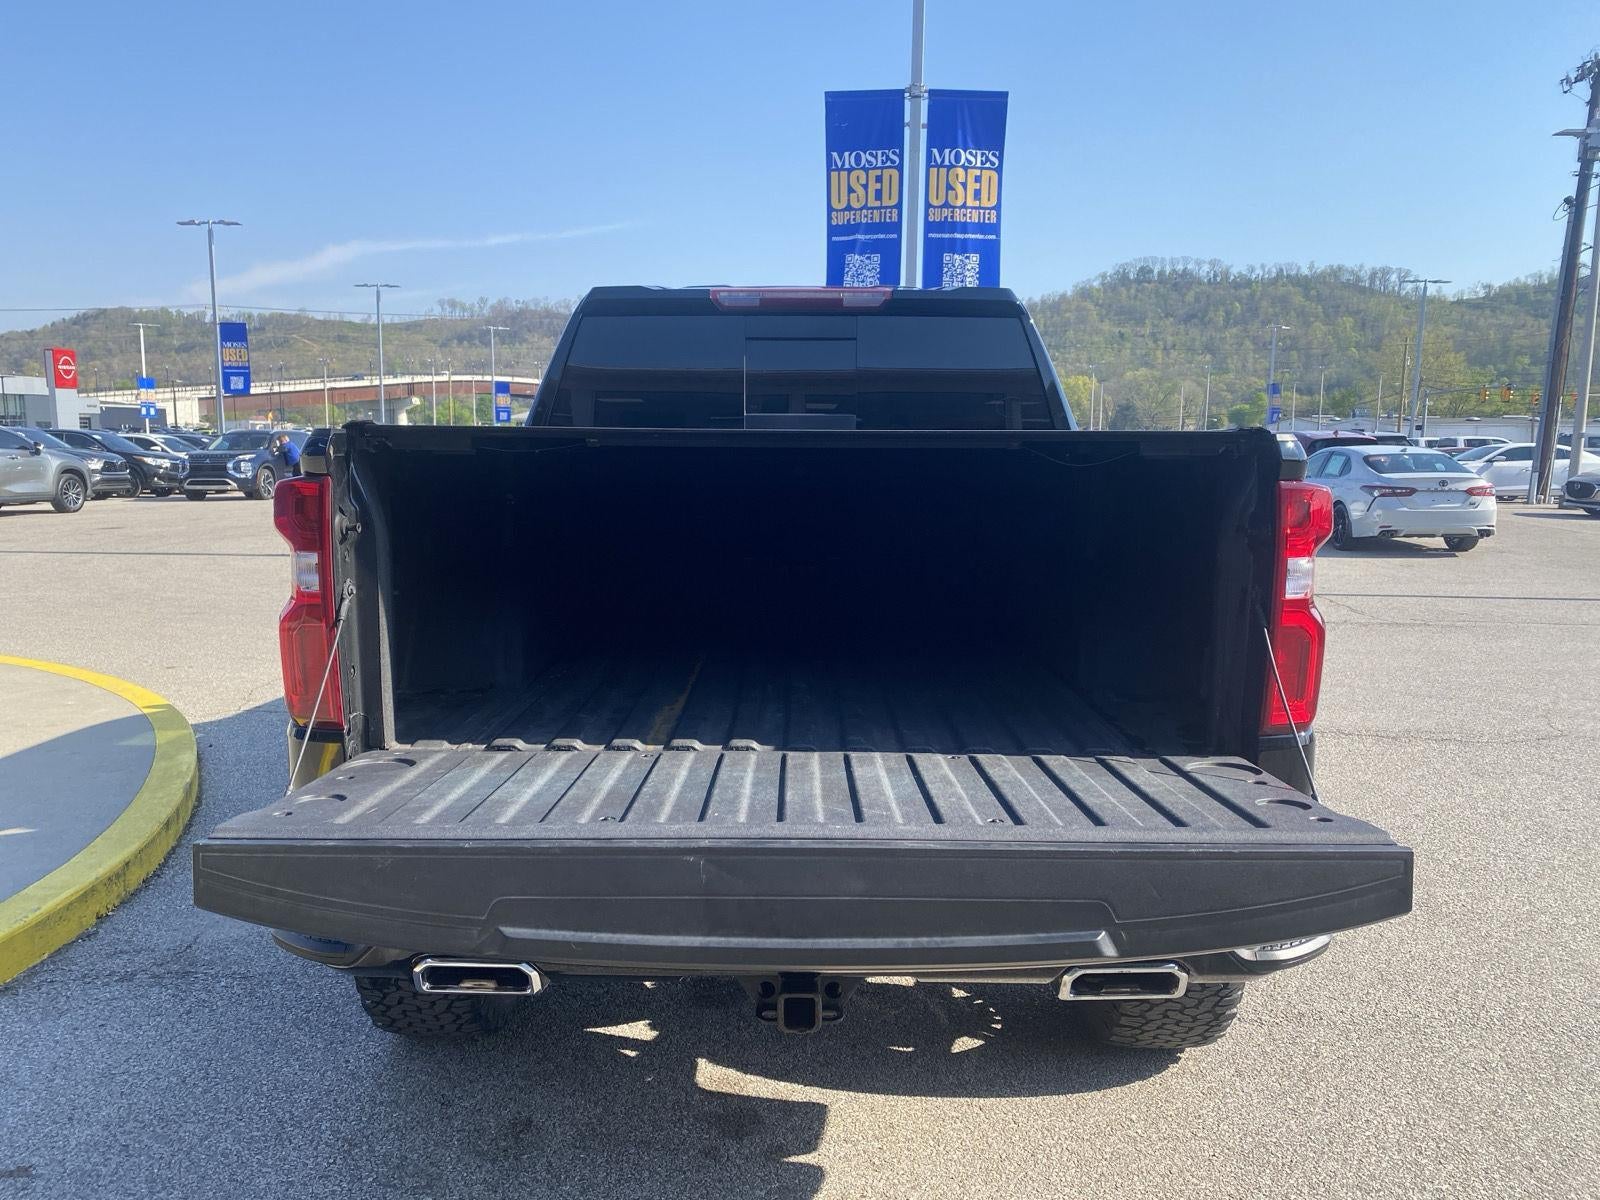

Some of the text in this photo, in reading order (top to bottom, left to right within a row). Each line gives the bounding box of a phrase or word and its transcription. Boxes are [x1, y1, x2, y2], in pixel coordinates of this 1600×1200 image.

[831, 148, 899, 169] MOSES
[930, 148, 999, 167] MOSES
[830, 168, 899, 210] USED
[928, 167, 998, 207] USED
[831, 208, 898, 225] SUPERCENTER
[928, 208, 996, 224] SUPERCENTER
[223, 348, 248, 362] USED
